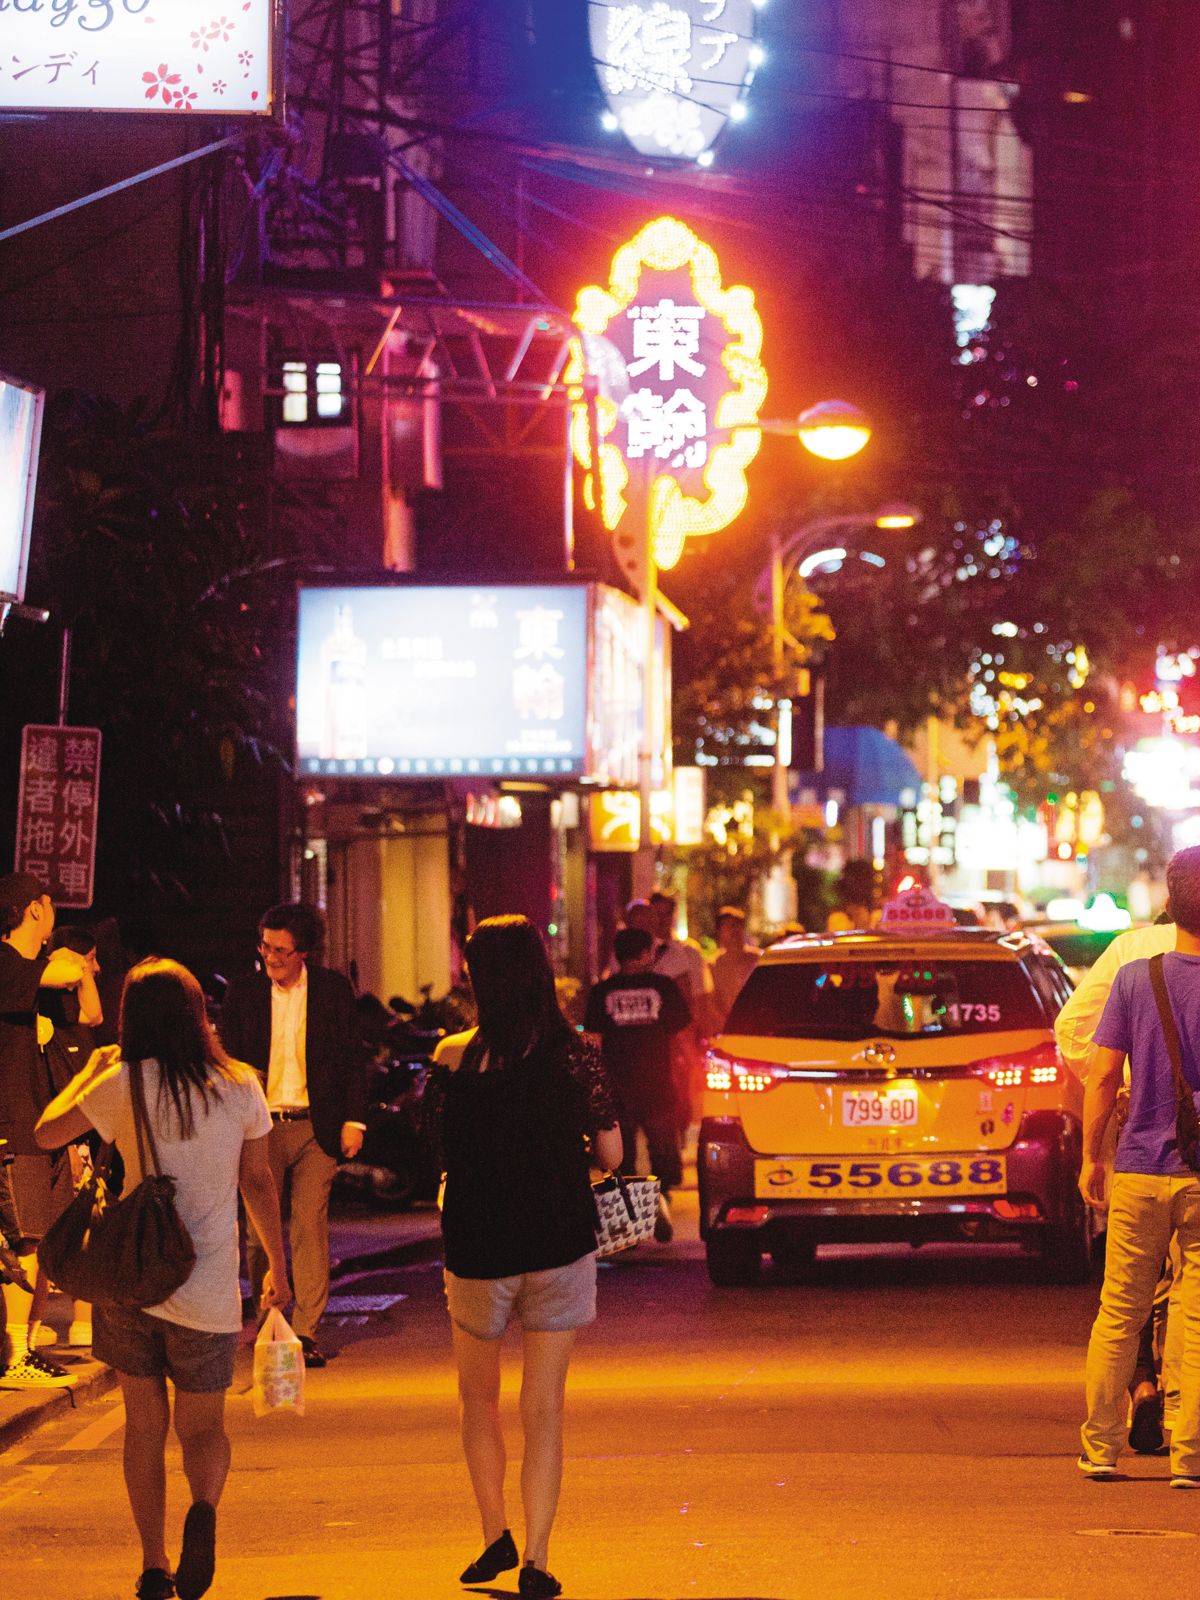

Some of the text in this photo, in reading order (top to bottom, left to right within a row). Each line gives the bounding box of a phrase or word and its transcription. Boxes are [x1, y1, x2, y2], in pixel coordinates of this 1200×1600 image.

[0, 51, 99, 85] ンディ
[59, 737, 96, 897] 禁停外車
[948, 1003, 1001, 1022] 1735
[807, 1160, 1003, 1189] 55688
